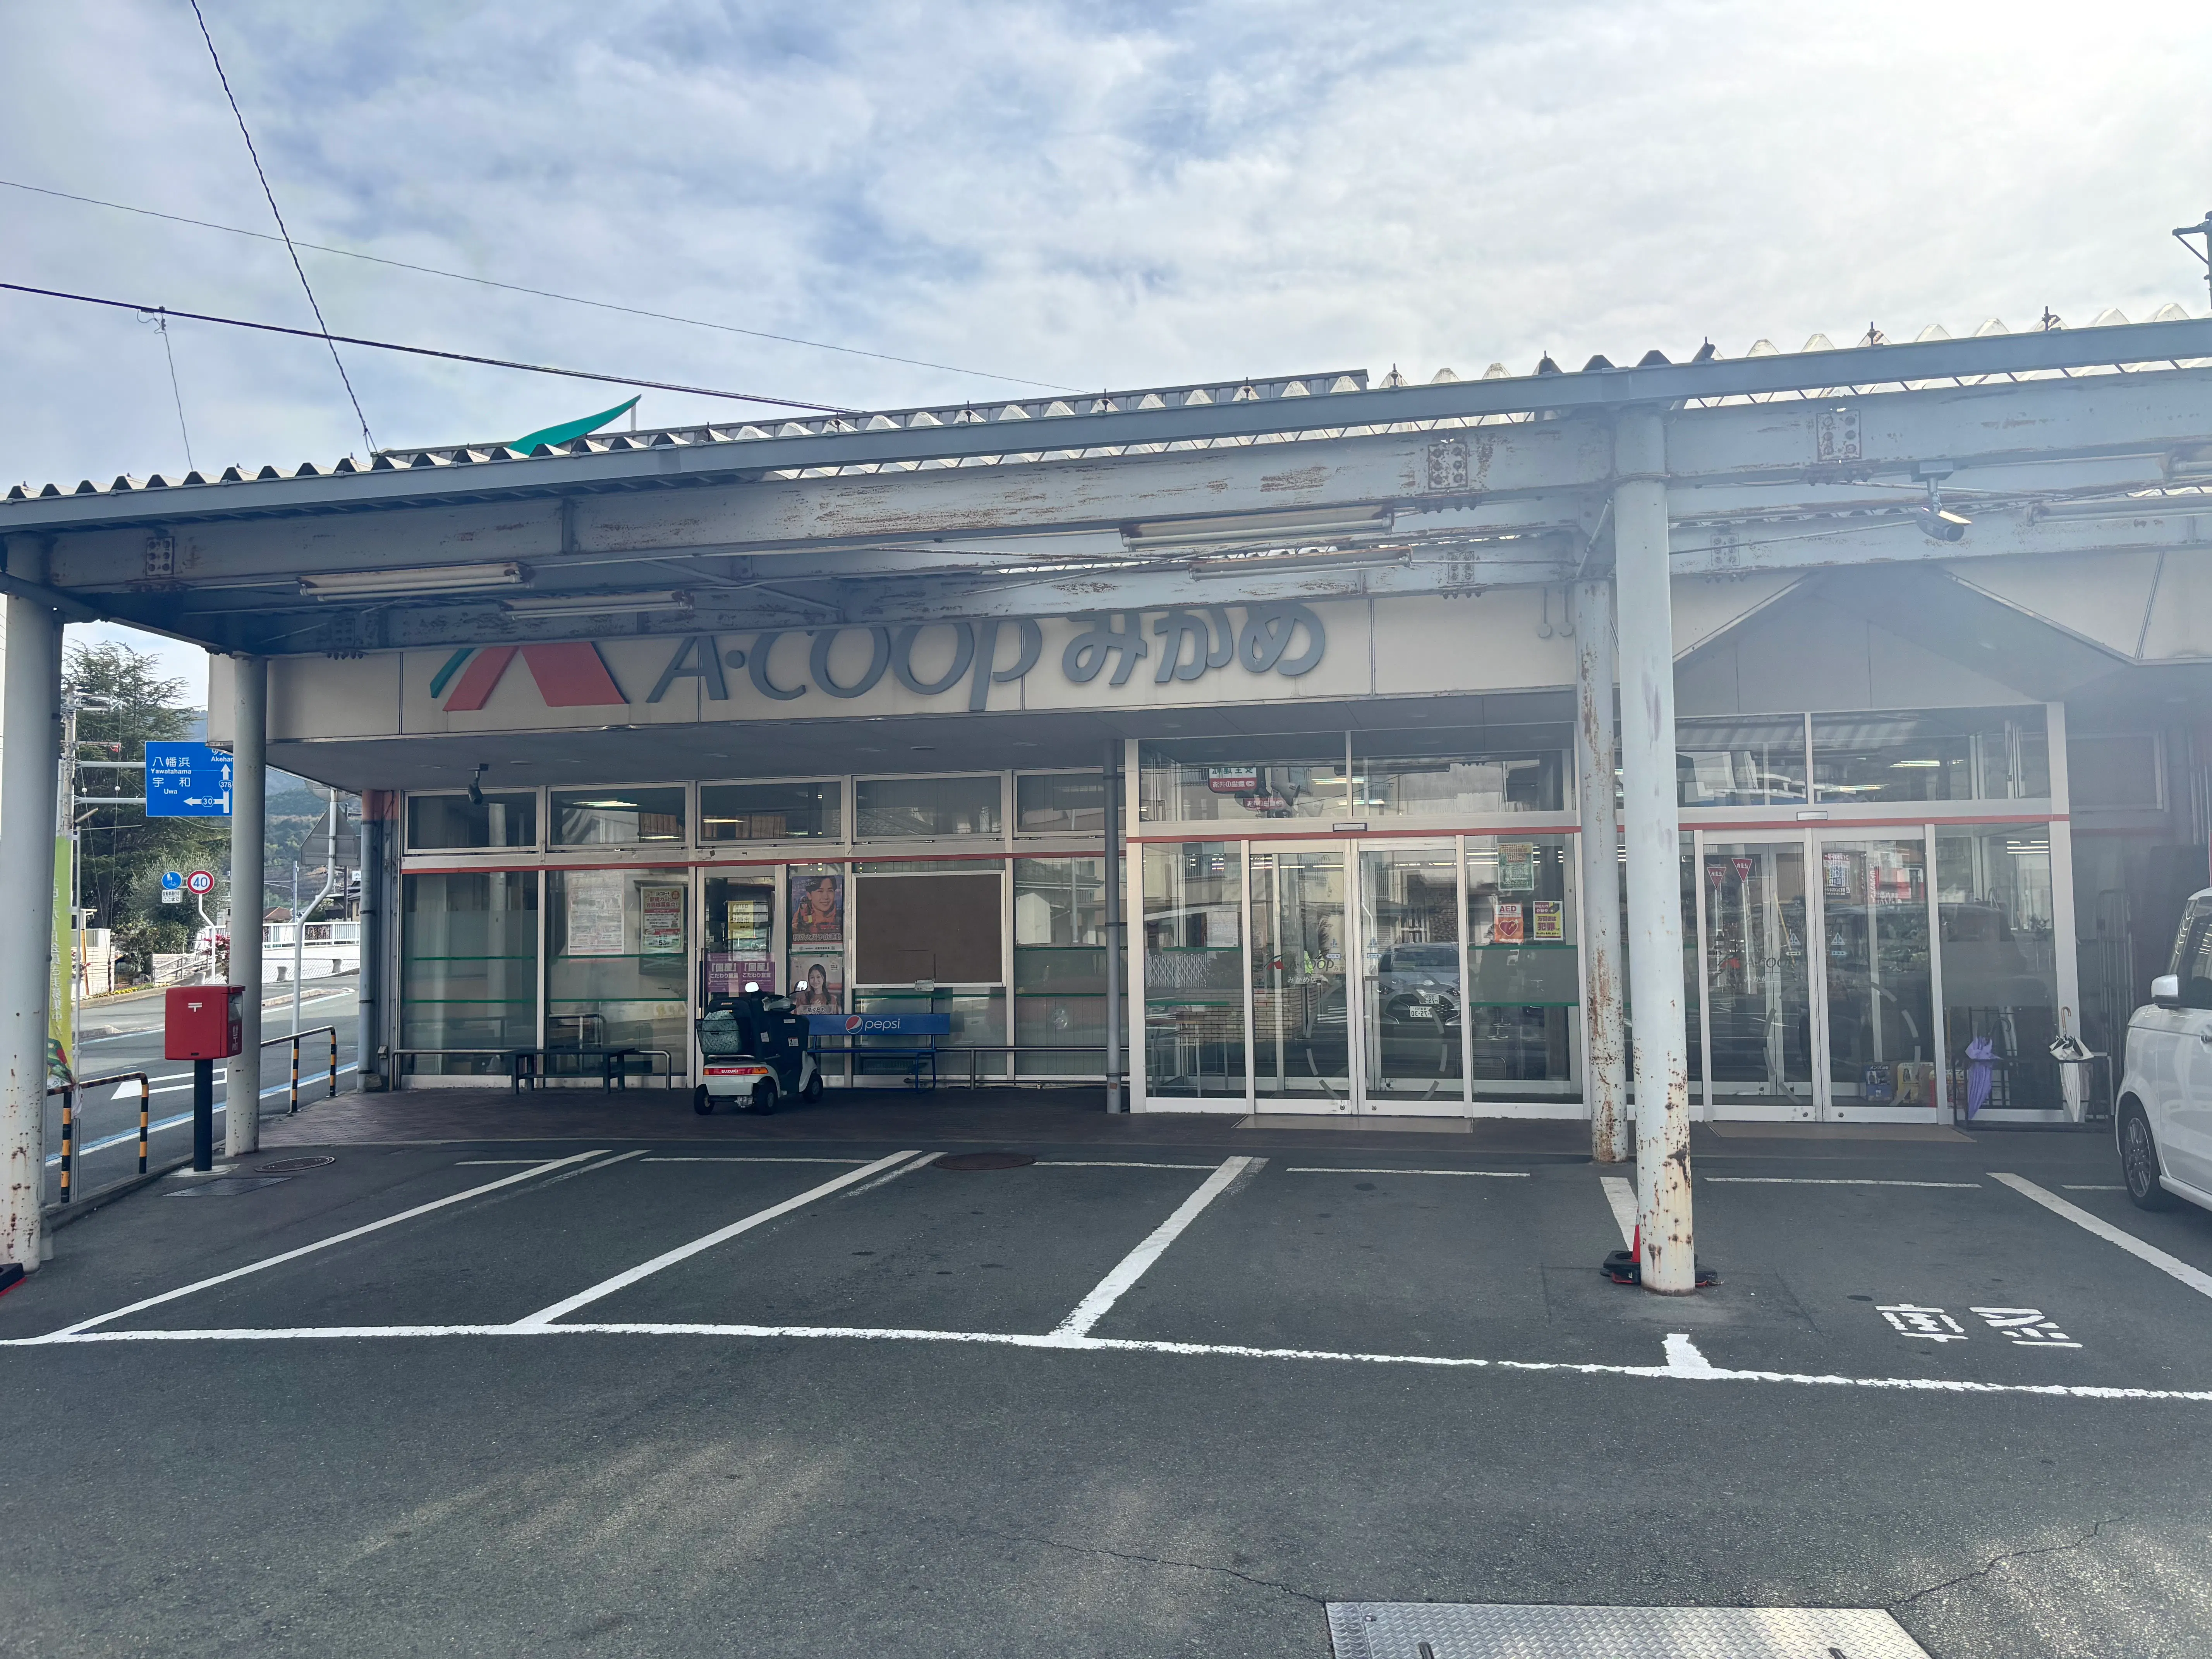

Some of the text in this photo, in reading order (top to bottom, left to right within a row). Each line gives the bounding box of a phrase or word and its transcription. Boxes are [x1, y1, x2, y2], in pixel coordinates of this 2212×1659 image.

[1062, 605, 1326, 685] みかめ
[152, 757, 191, 767] 八幡浜
[193, 877, 208, 887] 40
[865, 1018, 900, 1031] pepsi
